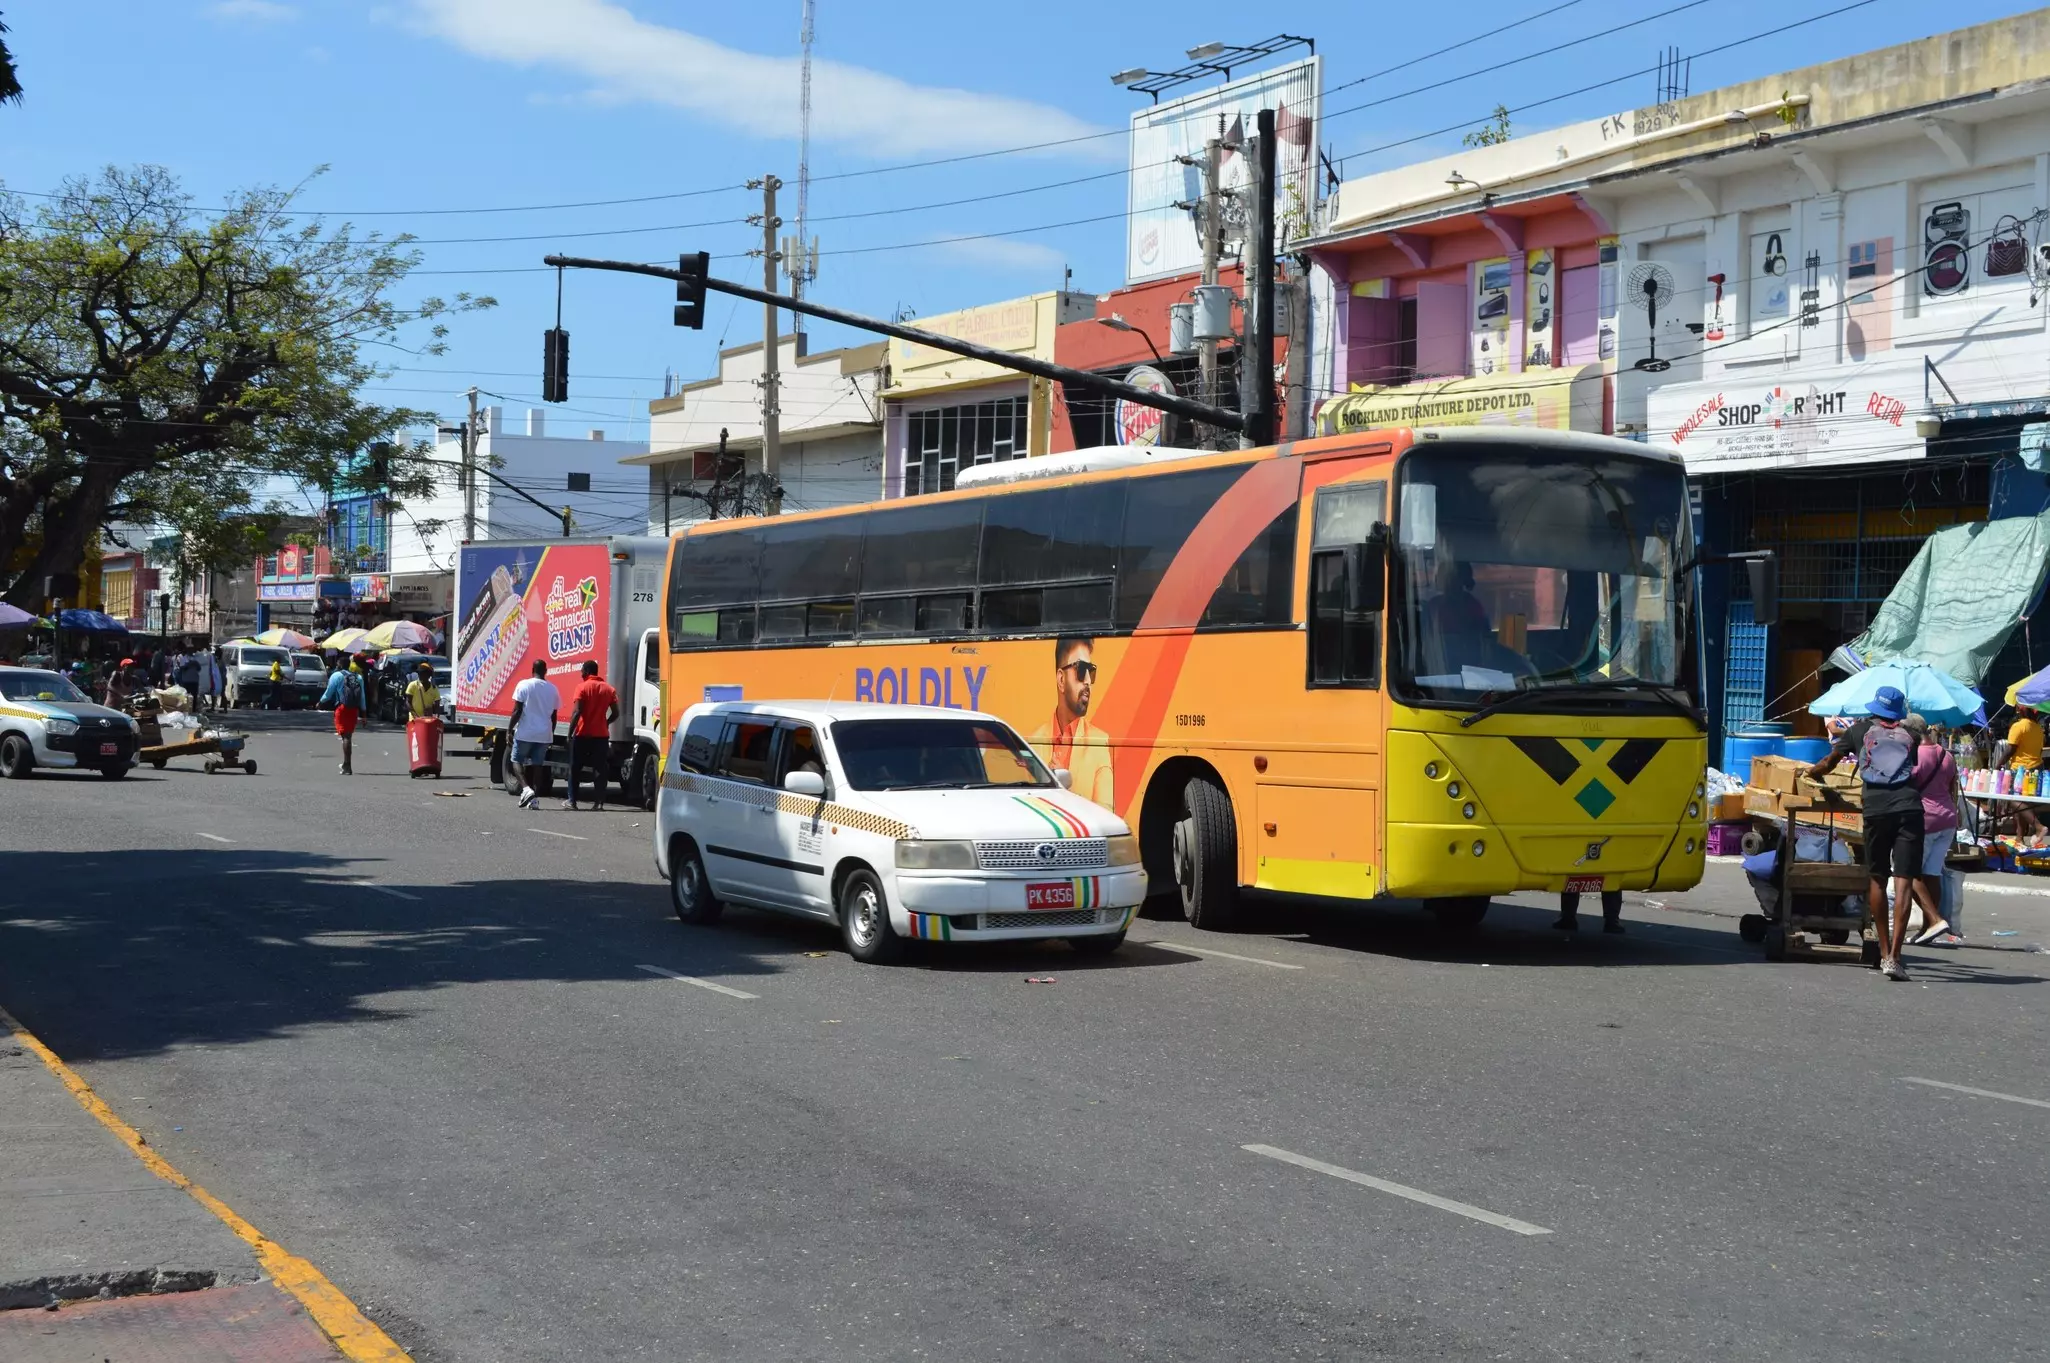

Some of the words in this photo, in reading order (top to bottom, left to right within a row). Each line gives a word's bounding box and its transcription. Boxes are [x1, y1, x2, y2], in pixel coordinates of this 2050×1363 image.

[1342, 406, 1399, 426] ROCKLAND
[1401, 399, 1464, 420] FURNITURE
[1467, 396, 1506, 413] DEPOT
[1508, 392, 1534, 408] LTD.
[1671, 392, 1725, 445] WHOLESALE
[1718, 404, 1761, 426] SHOP
[1794, 391, 1846, 415] RGHT
[1866, 391, 1906, 427] RETAIL
[1125, 407, 1163, 446] KING
[553, 578, 563, 598] di
[565, 588, 582, 610] real
[632, 592, 654, 603] 278
[549, 607, 593, 631] Jamaican
[466, 623, 501, 683] GIANT
[550, 624, 593, 654] GIANT
[856, 666, 987, 711] BOLDLY
[1176, 714, 1206, 726] 15D1996
[1029, 889, 1043, 904] PK
[1045, 888, 1073, 903] 4356
